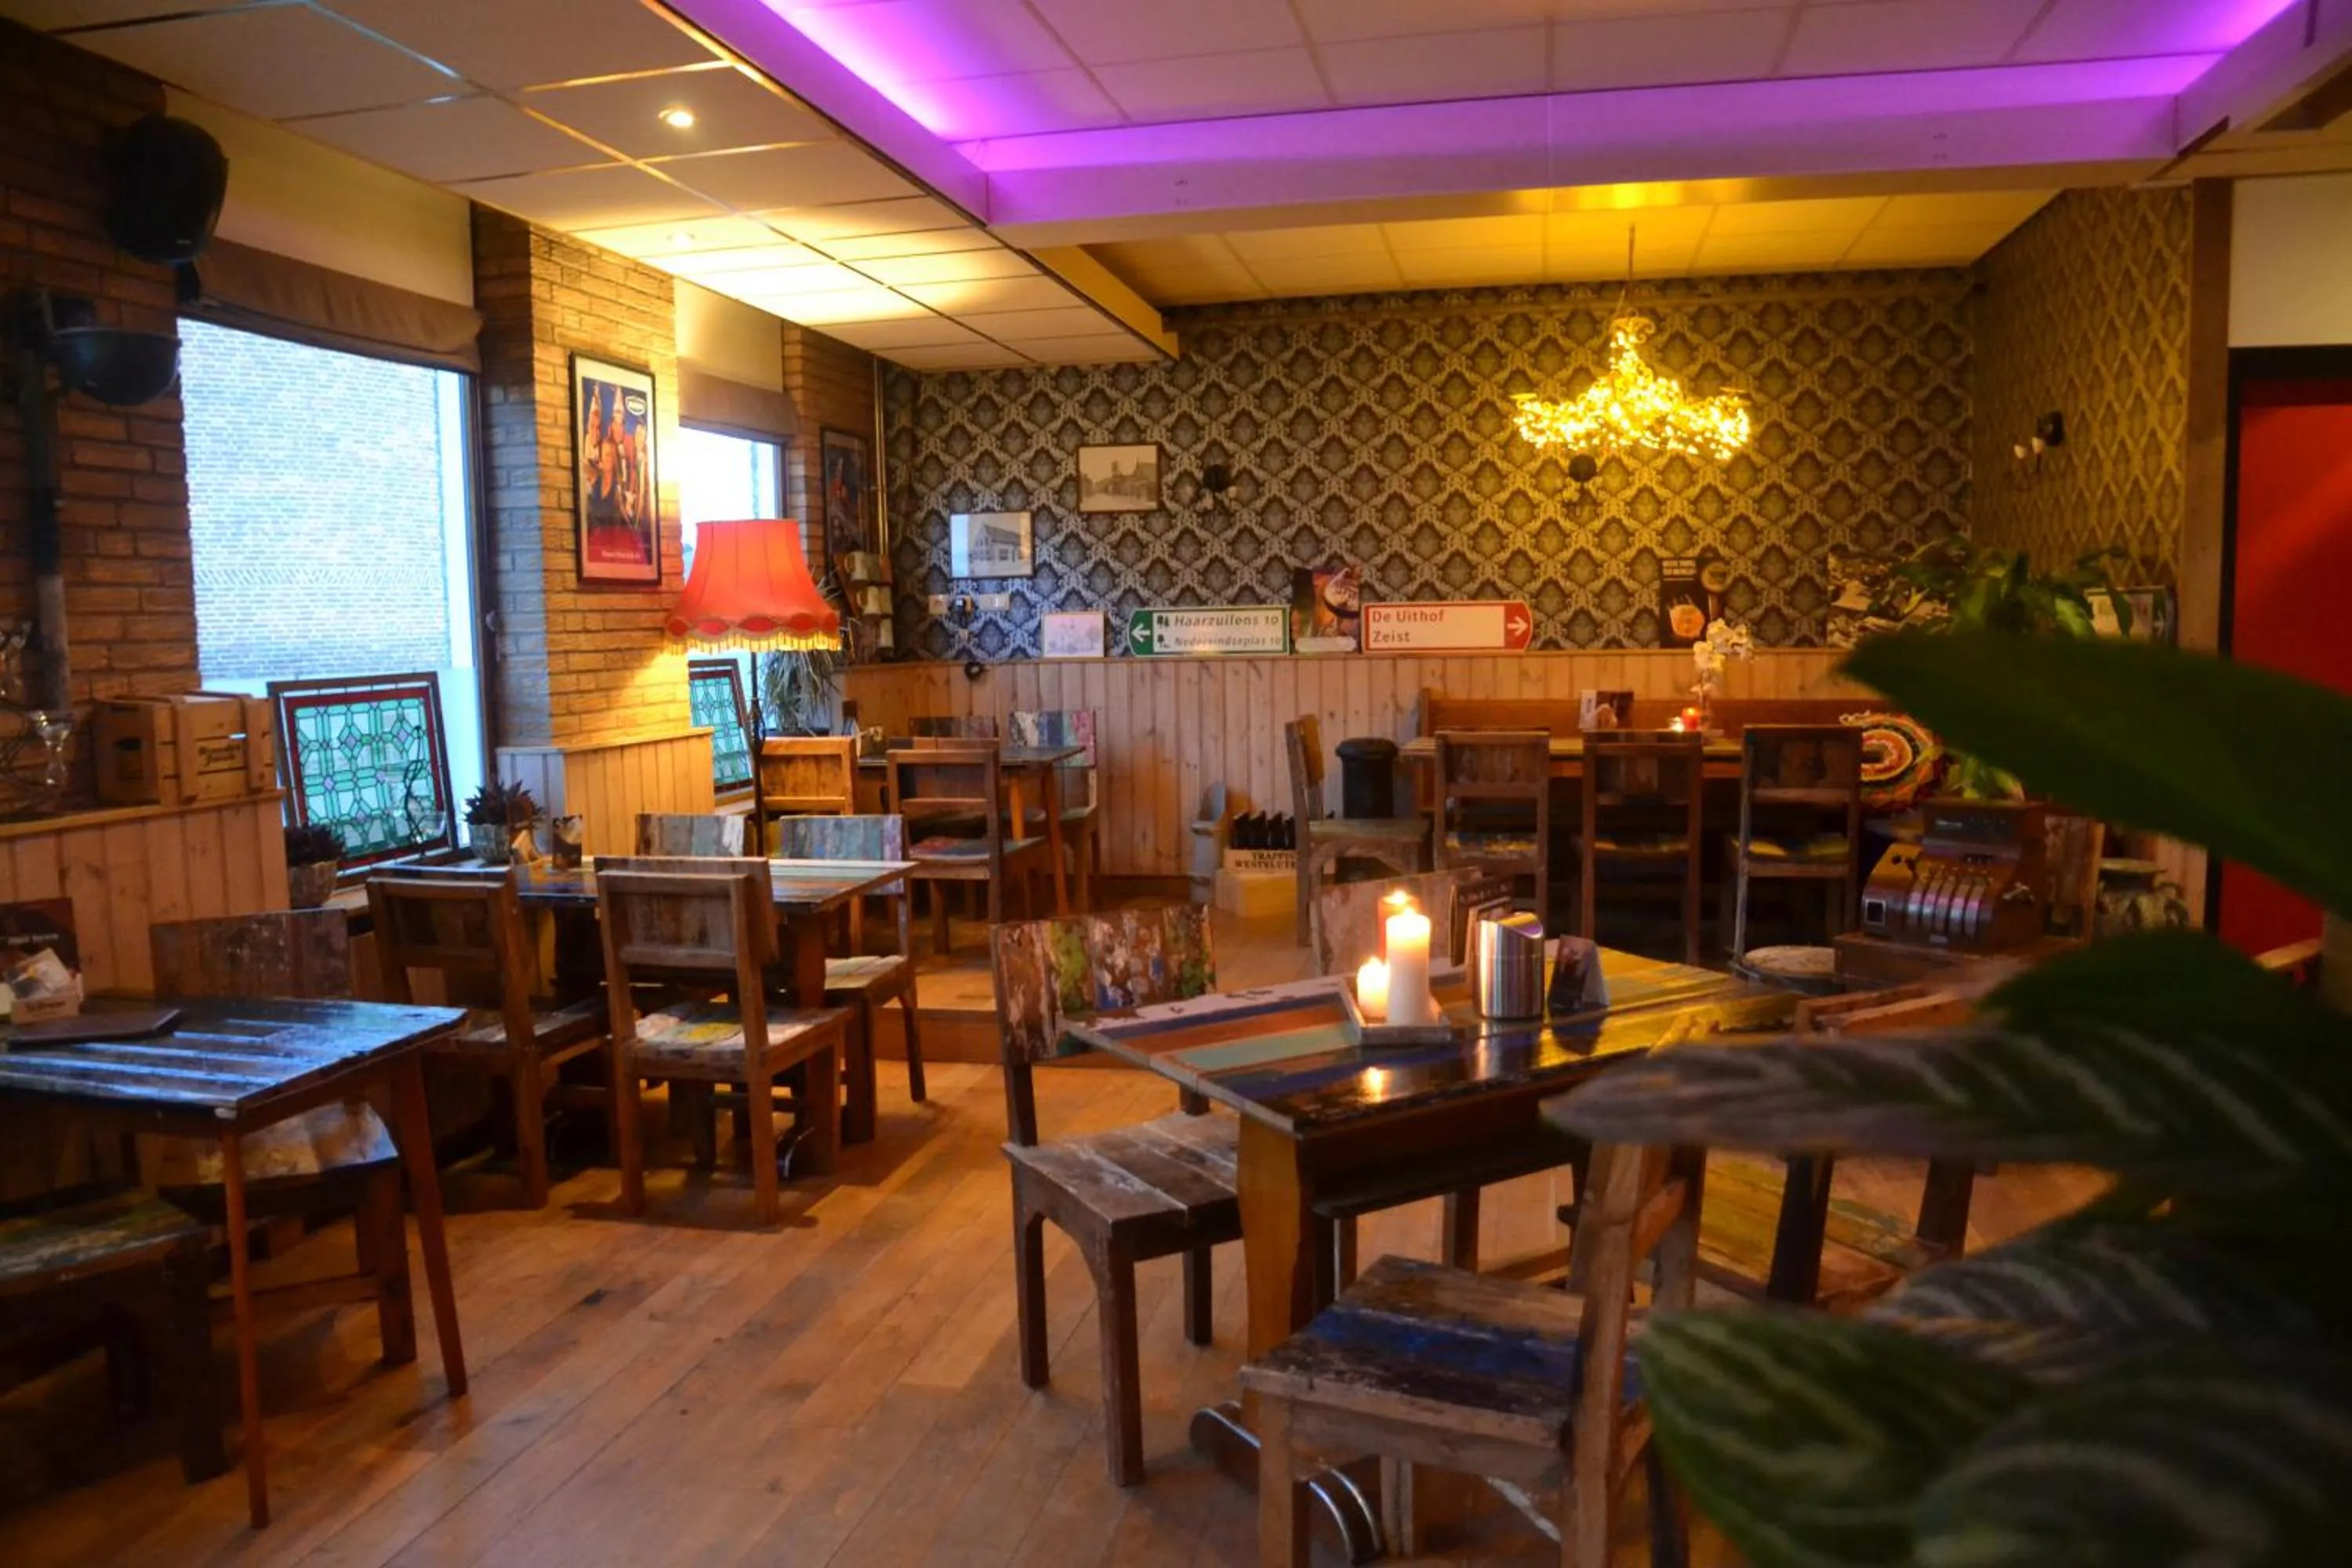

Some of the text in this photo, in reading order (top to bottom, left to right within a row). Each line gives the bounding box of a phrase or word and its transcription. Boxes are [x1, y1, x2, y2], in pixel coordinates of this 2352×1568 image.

[1265, 615, 1279, 626] 10
[1372, 610, 1444, 622] De Uithof
[1372, 630, 1411, 643] Zeist
[1252, 851, 1297, 860] TRAPPIS
[1235, 859, 1297, 869] WESTVLETE
